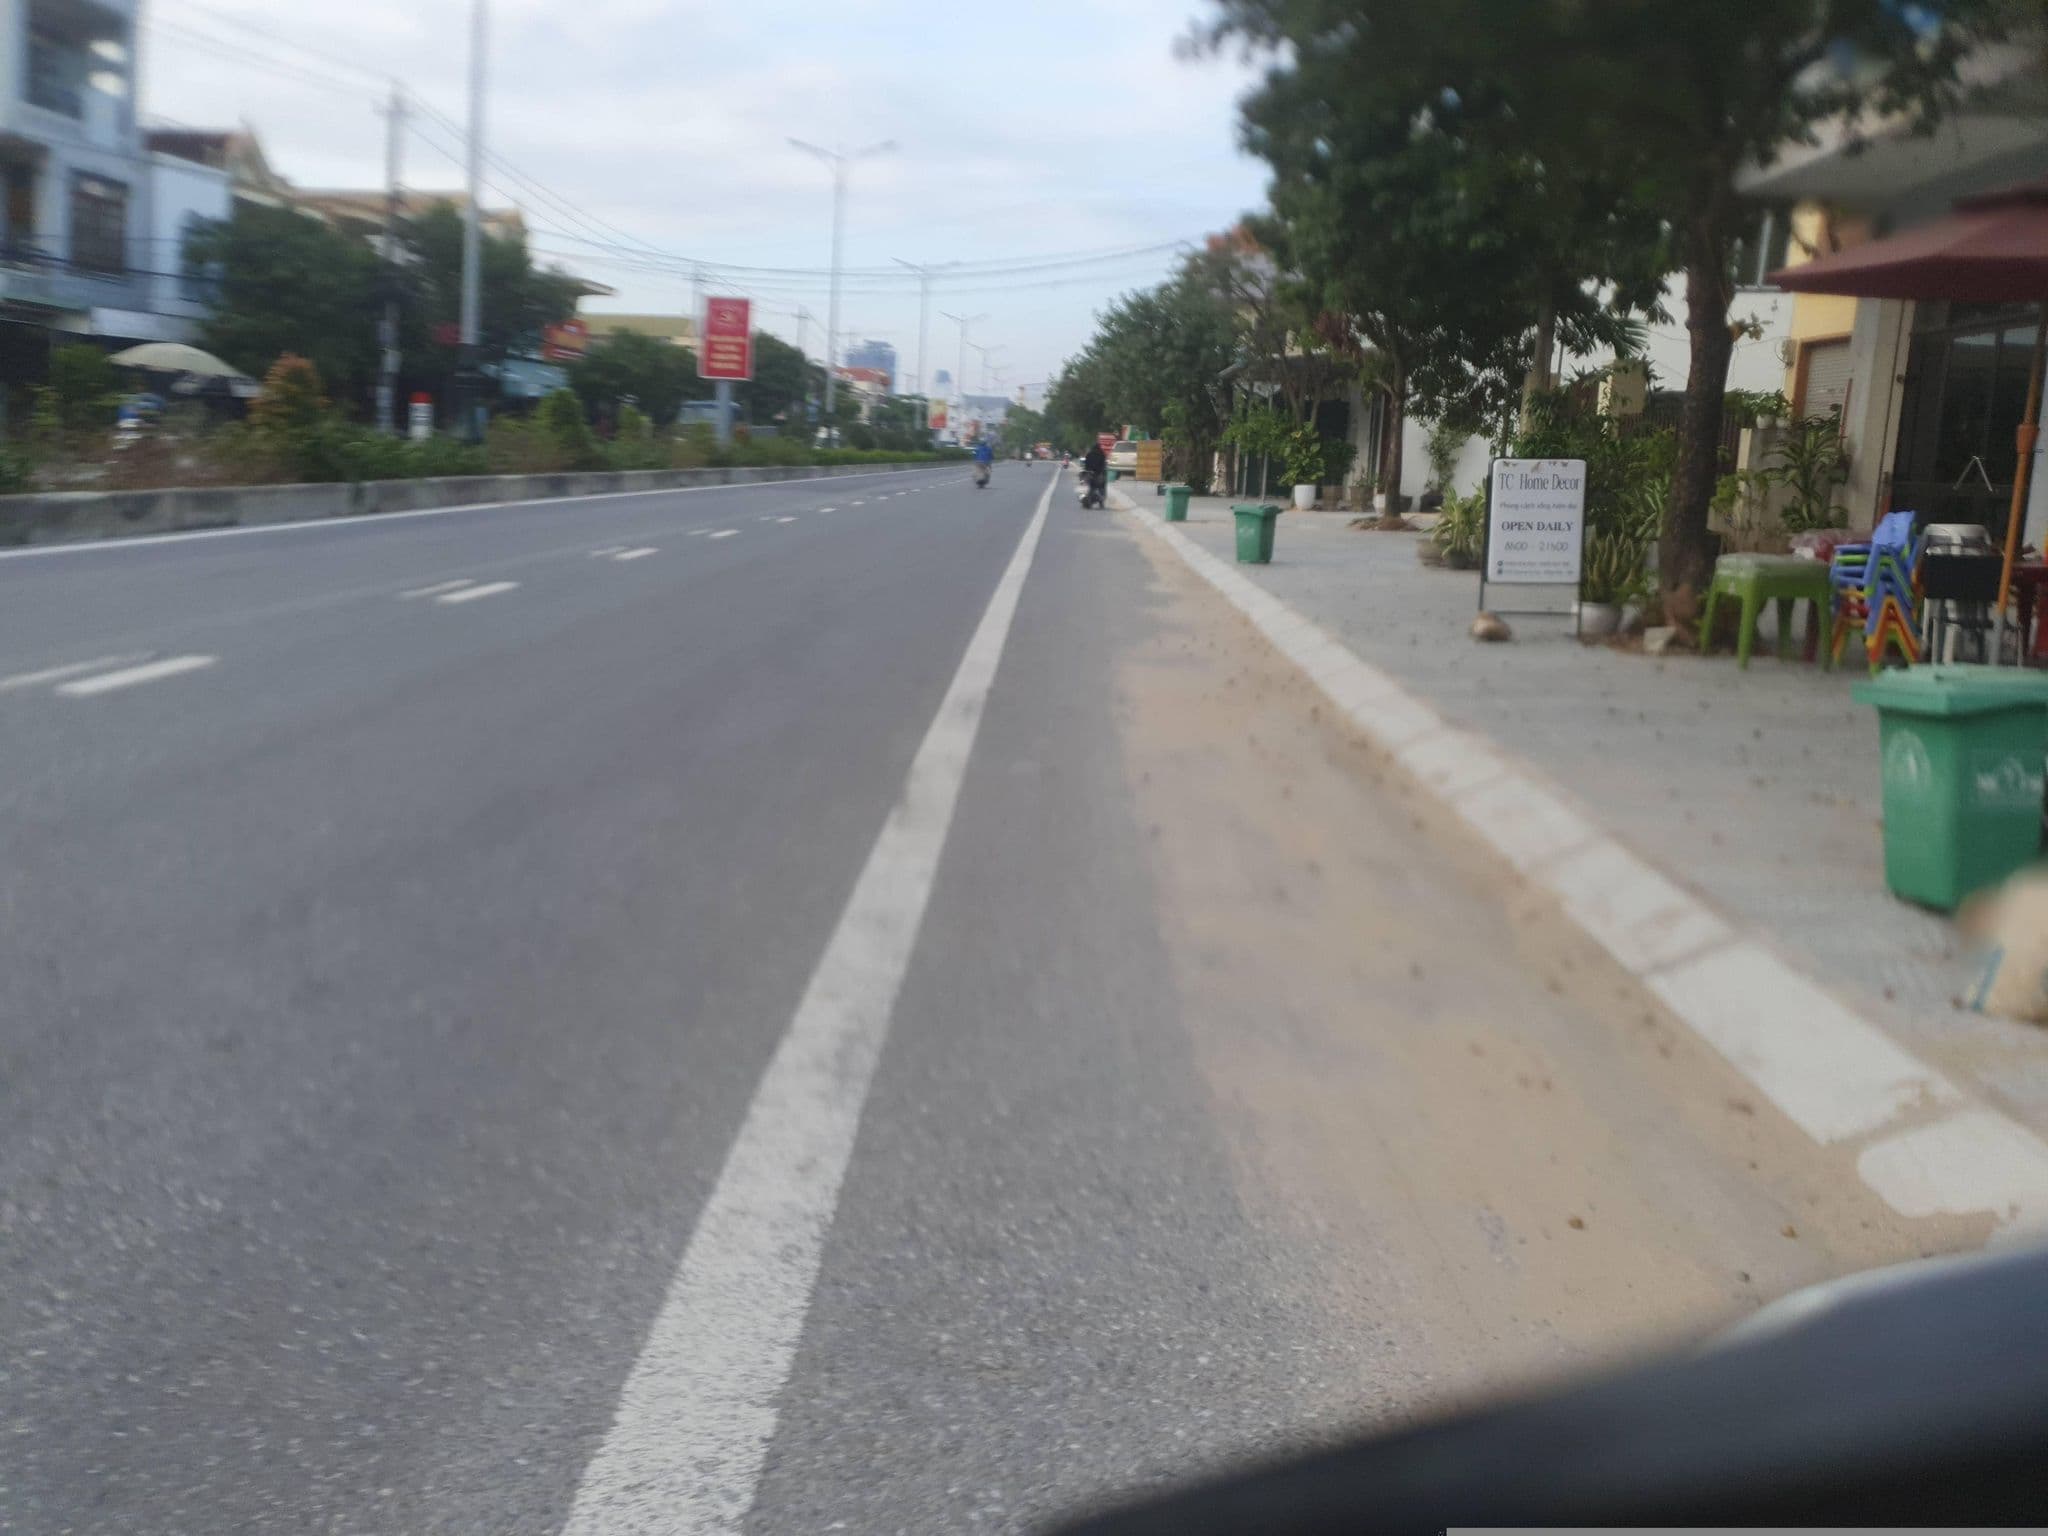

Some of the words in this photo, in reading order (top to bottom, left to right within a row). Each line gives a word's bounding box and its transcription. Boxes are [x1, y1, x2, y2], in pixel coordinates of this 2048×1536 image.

[1498, 473, 1514, 490] TC
[1520, 473, 1549, 490] Home
[1552, 473, 1579, 490] Decor
[1501, 521, 1534, 531] OPEN
[1536, 521, 1574, 531] DAILY
